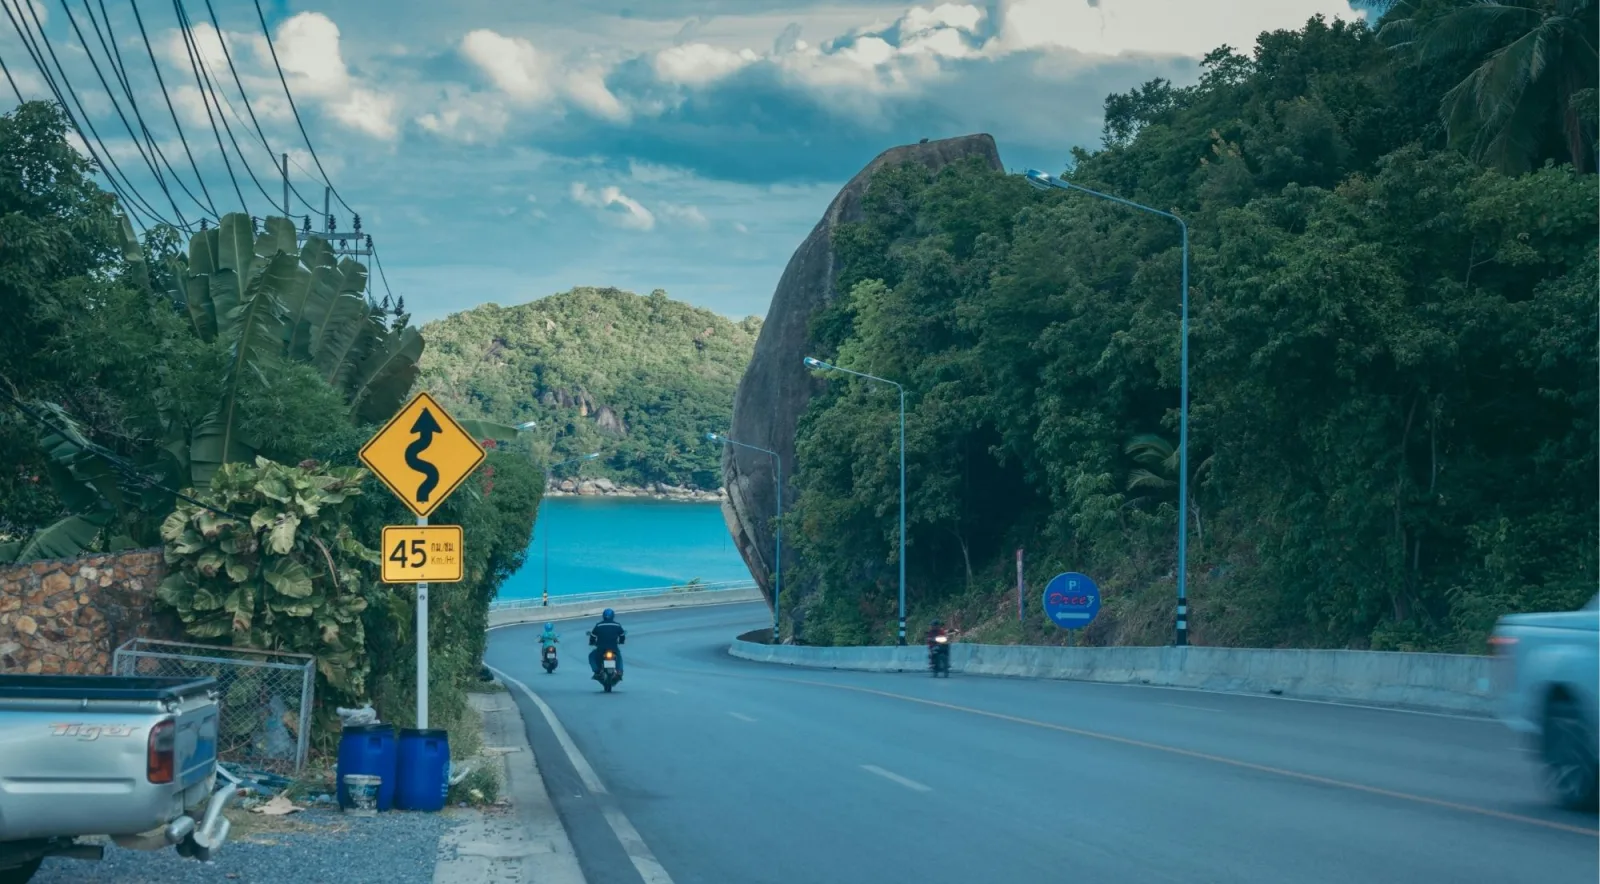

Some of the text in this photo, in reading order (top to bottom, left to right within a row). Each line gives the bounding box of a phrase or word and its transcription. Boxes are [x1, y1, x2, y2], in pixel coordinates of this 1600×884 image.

[389, 539, 427, 569] 45
[1068, 580, 1077, 591] P
[48, 722, 141, 742] Tiger
